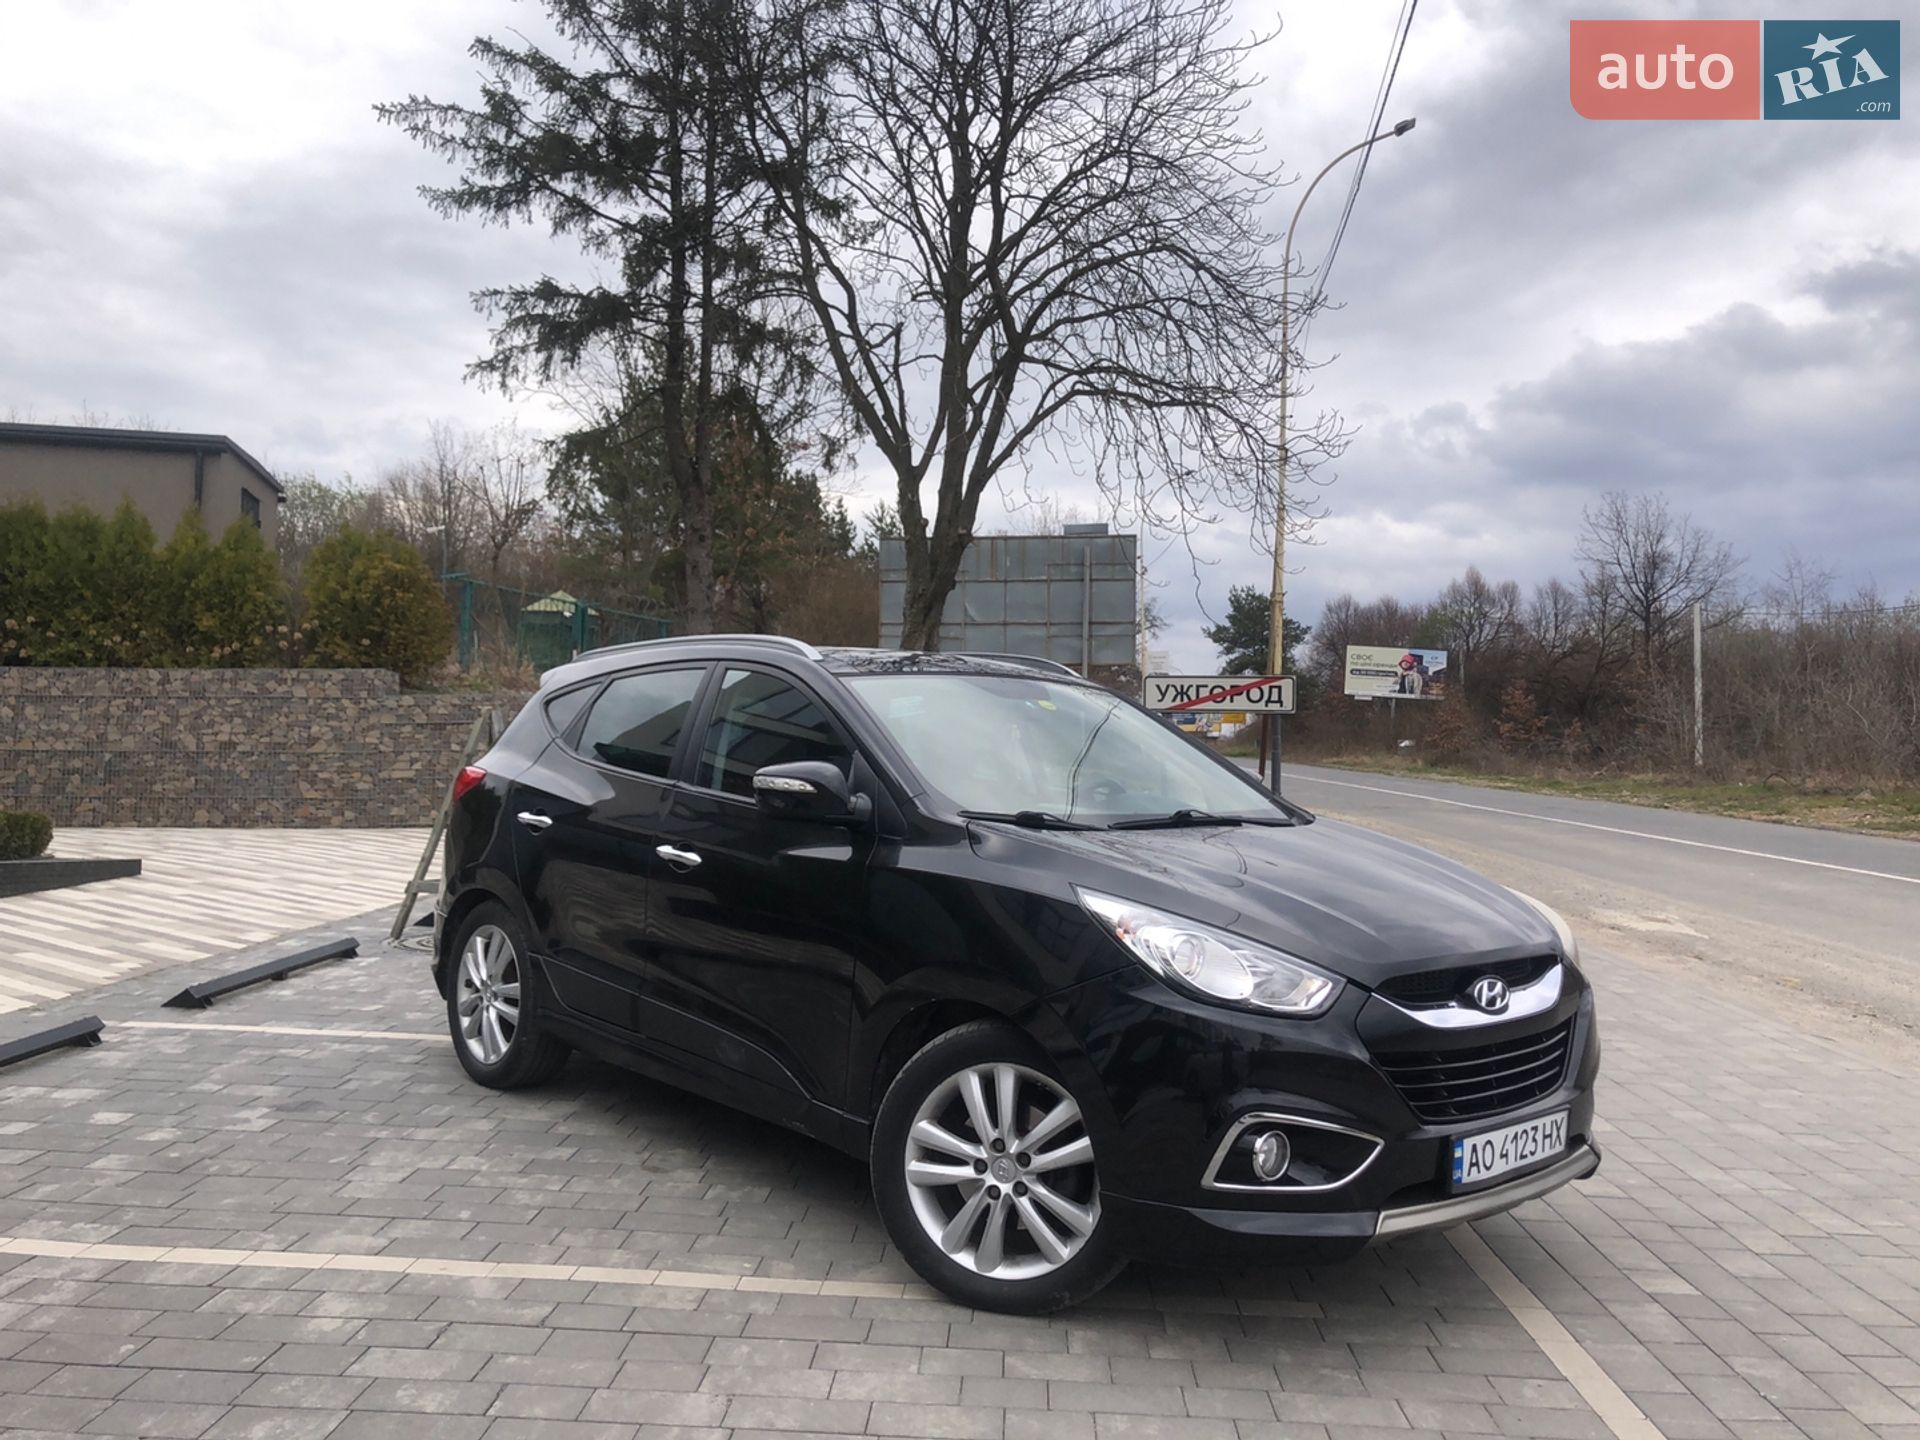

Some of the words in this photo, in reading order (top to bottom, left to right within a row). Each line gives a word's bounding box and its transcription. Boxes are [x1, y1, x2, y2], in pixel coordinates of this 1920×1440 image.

[1155, 683, 1284, 708] УЖГОРОД
[1467, 1139, 1495, 1177] AO
[1500, 1125, 1539, 1165] 4123
[1542, 1116, 1565, 1153] HX
